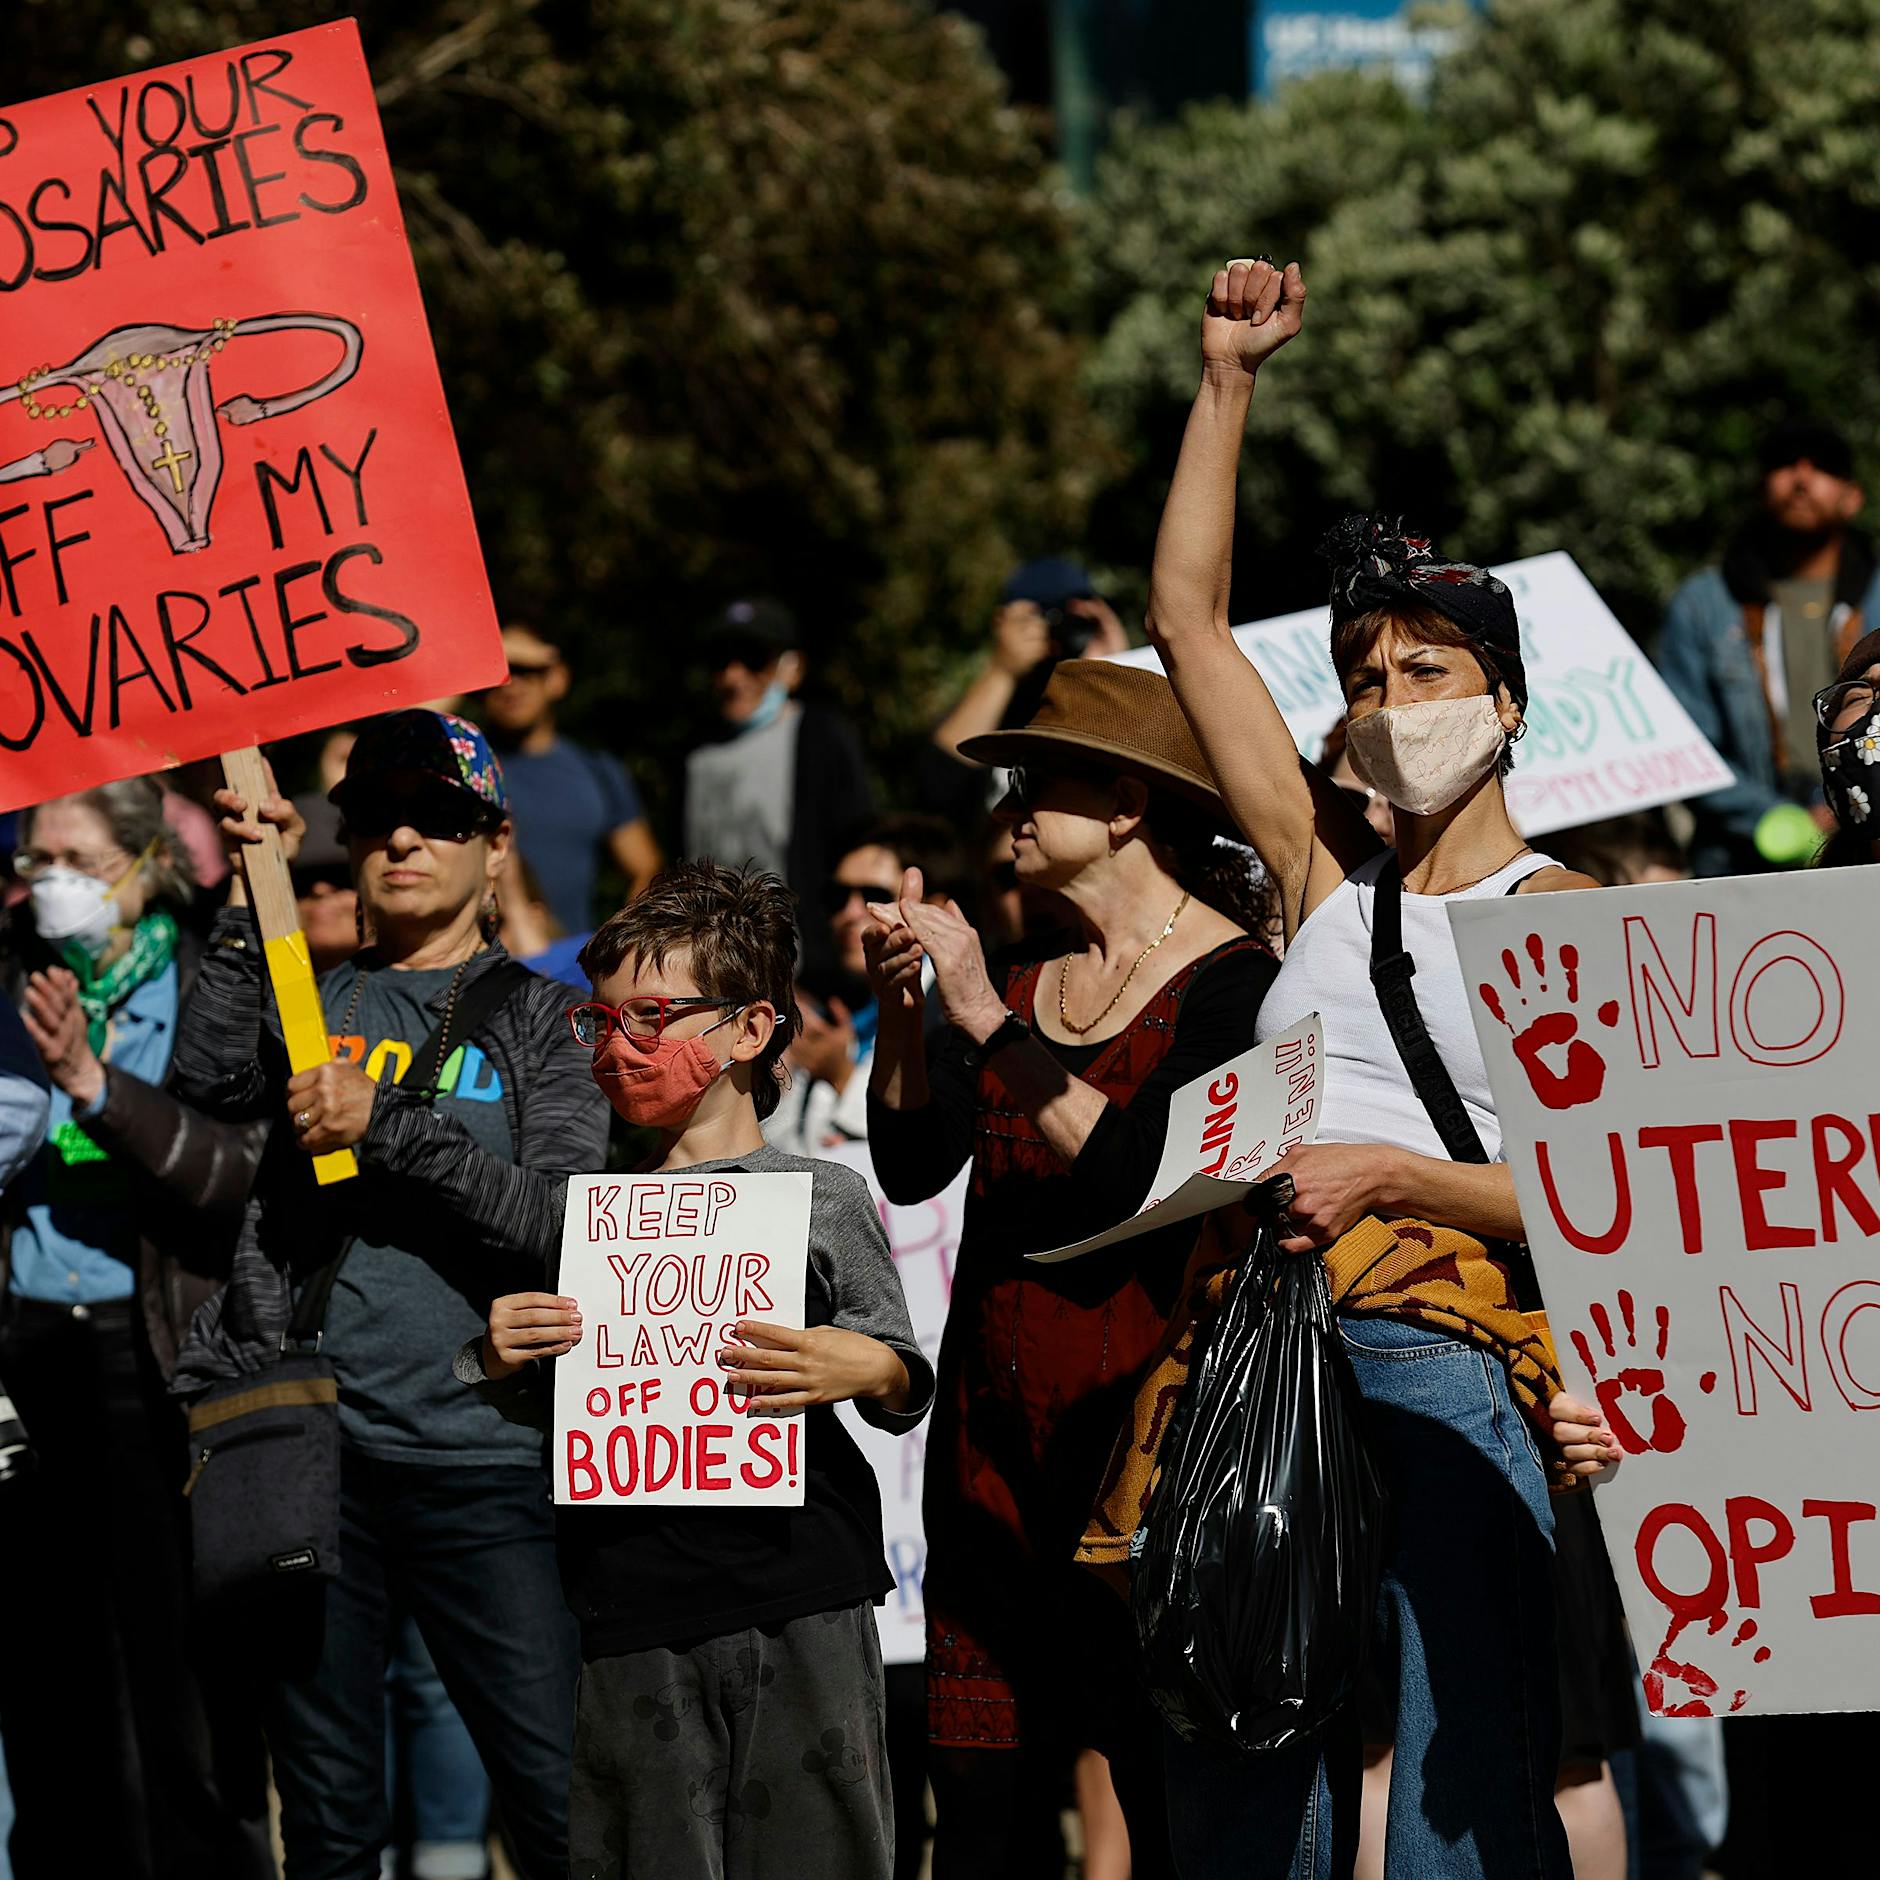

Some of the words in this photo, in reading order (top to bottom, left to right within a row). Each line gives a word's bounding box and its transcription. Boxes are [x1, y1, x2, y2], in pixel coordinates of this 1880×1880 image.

[87, 49, 315, 190] YOUR
[255, 428, 377, 549] MY
[1623, 912, 1845, 1068] NO
[587, 1181, 737, 1242] KEEP
[1536, 1113, 1880, 1255] UTER
[607, 1253, 775, 1317] YOUR
[586, 1379, 662, 1417] OFF
[566, 1423, 799, 1501] BODIES!
[1635, 1496, 1880, 1620] OPI
